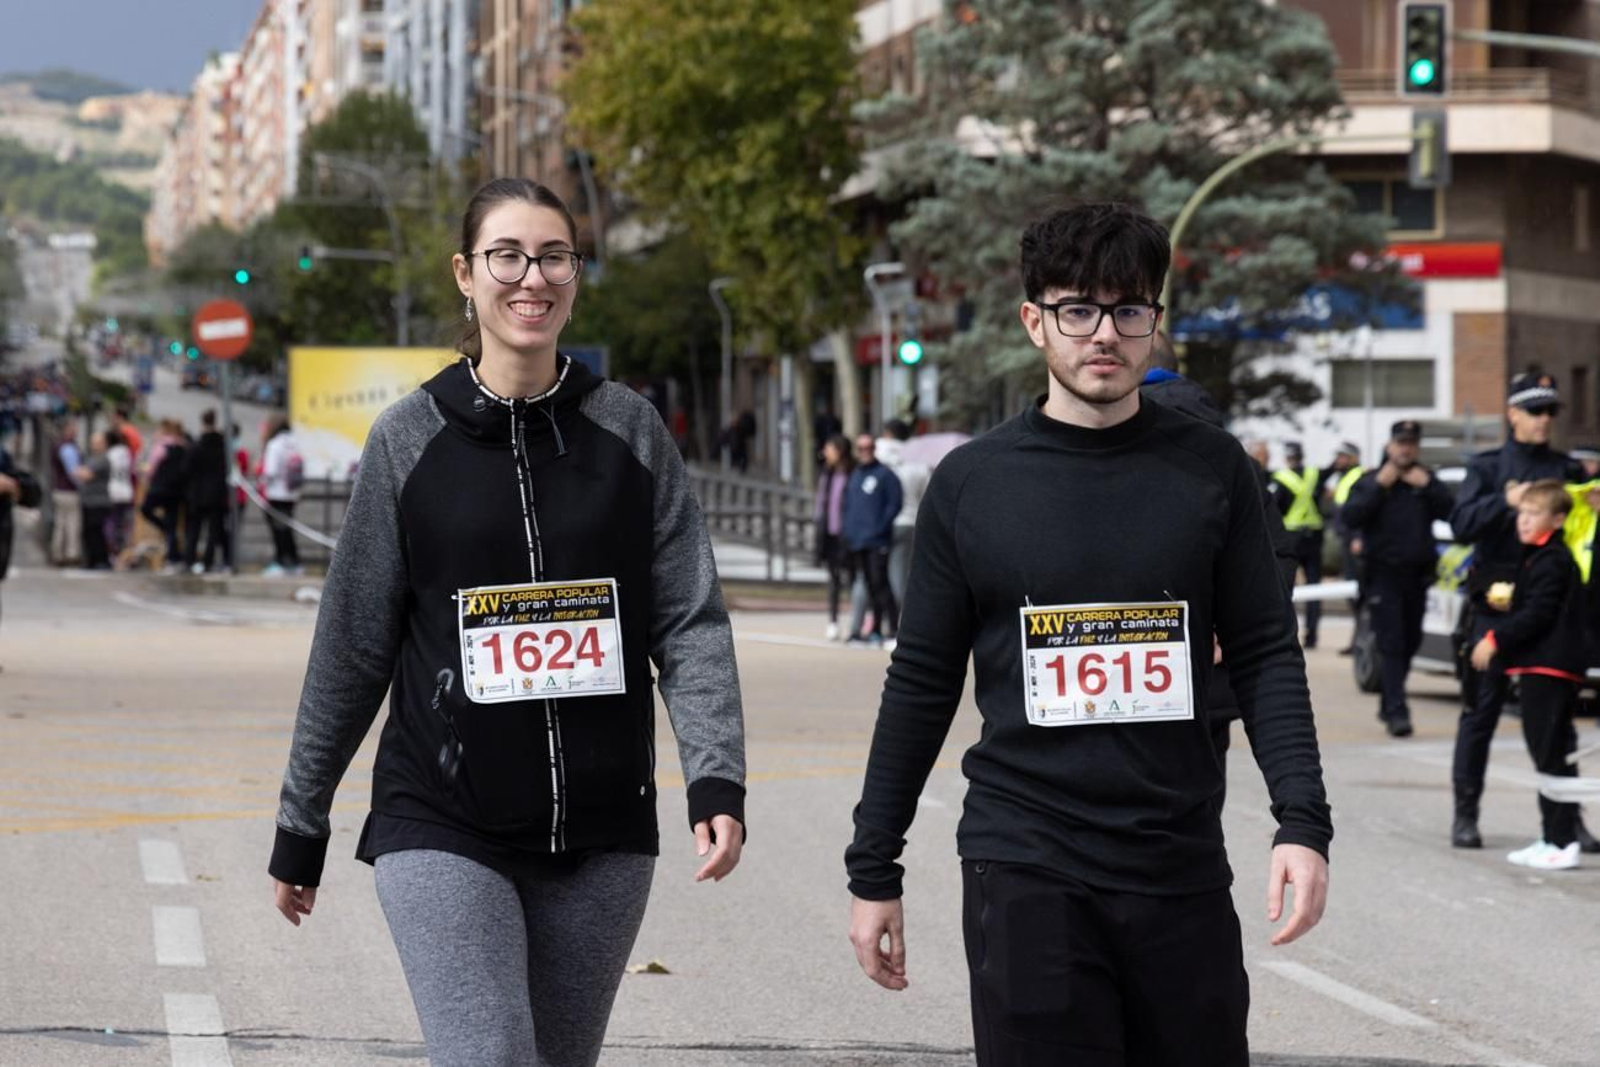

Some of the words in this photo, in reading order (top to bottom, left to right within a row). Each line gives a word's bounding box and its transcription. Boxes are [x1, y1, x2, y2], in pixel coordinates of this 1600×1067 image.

[502, 590, 554, 602] CARRERA
[556, 587, 608, 598] POPULAR
[467, 594, 500, 615] XXV
[503, 604, 510, 612] y
[518, 600, 548, 612] gran
[554, 596, 610, 608] caminata
[1030, 614, 1064, 635] XXV
[1066, 611, 1121, 622] CARRERA
[1124, 609, 1178, 619] POPULAR
[1067, 624, 1074, 632] y
[1083, 620, 1114, 632] gran
[1121, 618, 1179, 629] caminata
[482, 627, 605, 675] 1624
[1046, 650, 1172, 697] 1615
